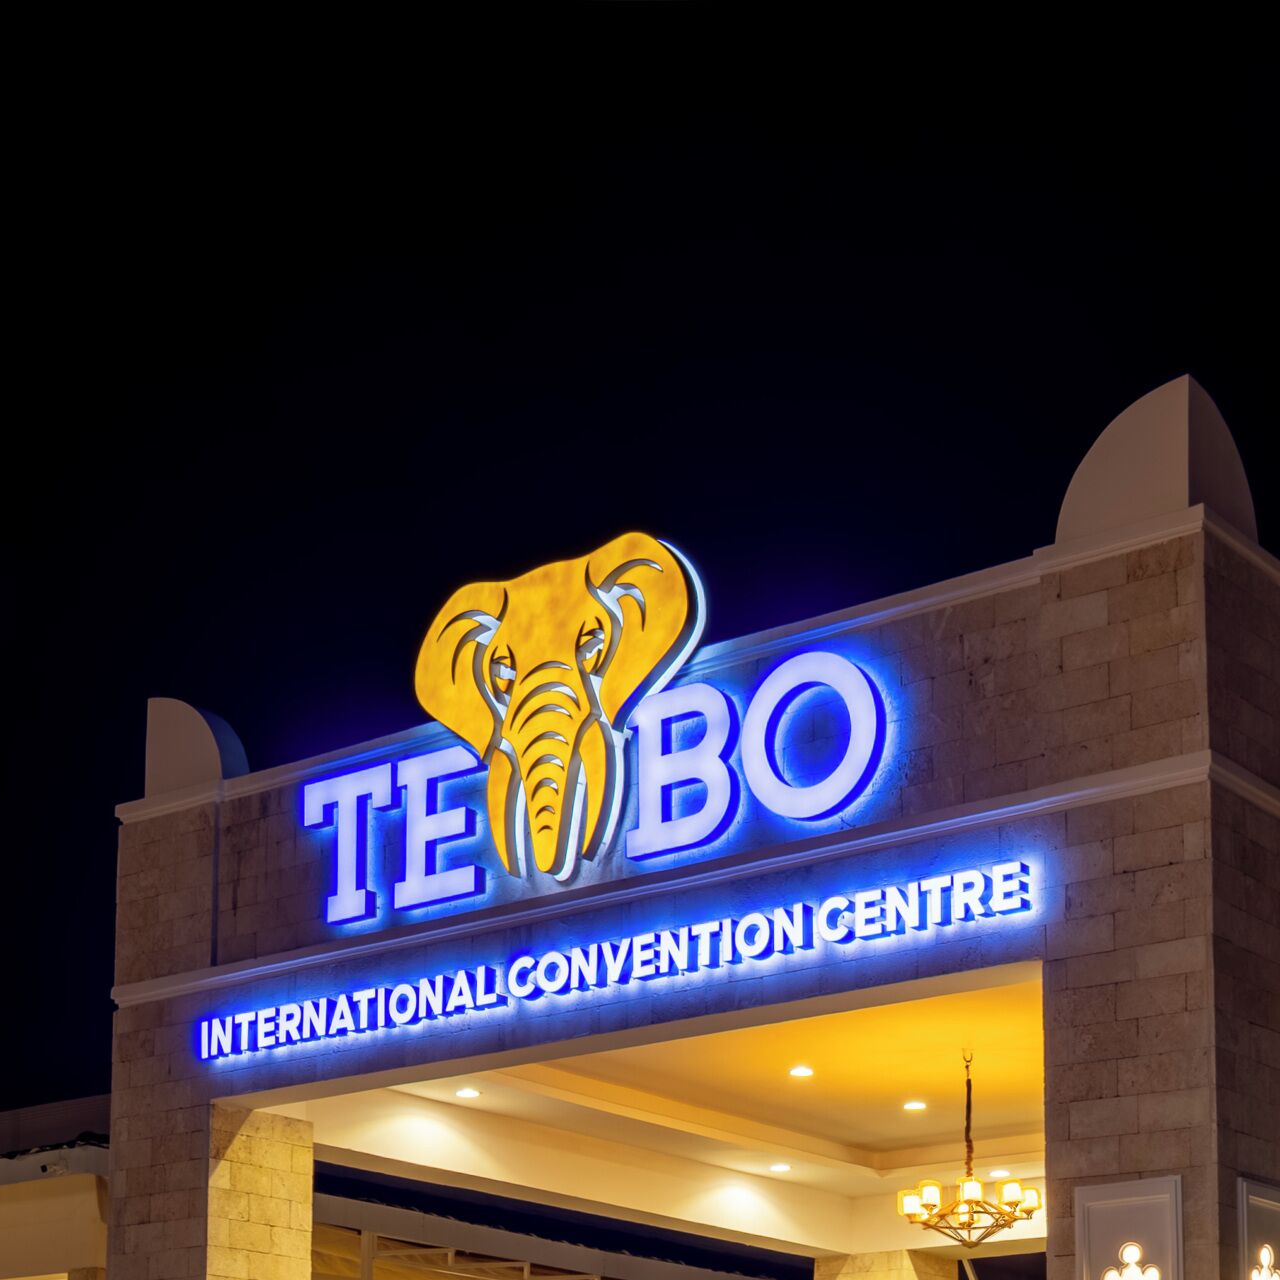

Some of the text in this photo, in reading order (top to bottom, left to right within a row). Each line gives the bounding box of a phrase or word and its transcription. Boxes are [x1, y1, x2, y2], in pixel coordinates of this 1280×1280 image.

[200, 861, 1024, 1060] INTERNATIONAL CONVENTION CENTRE
